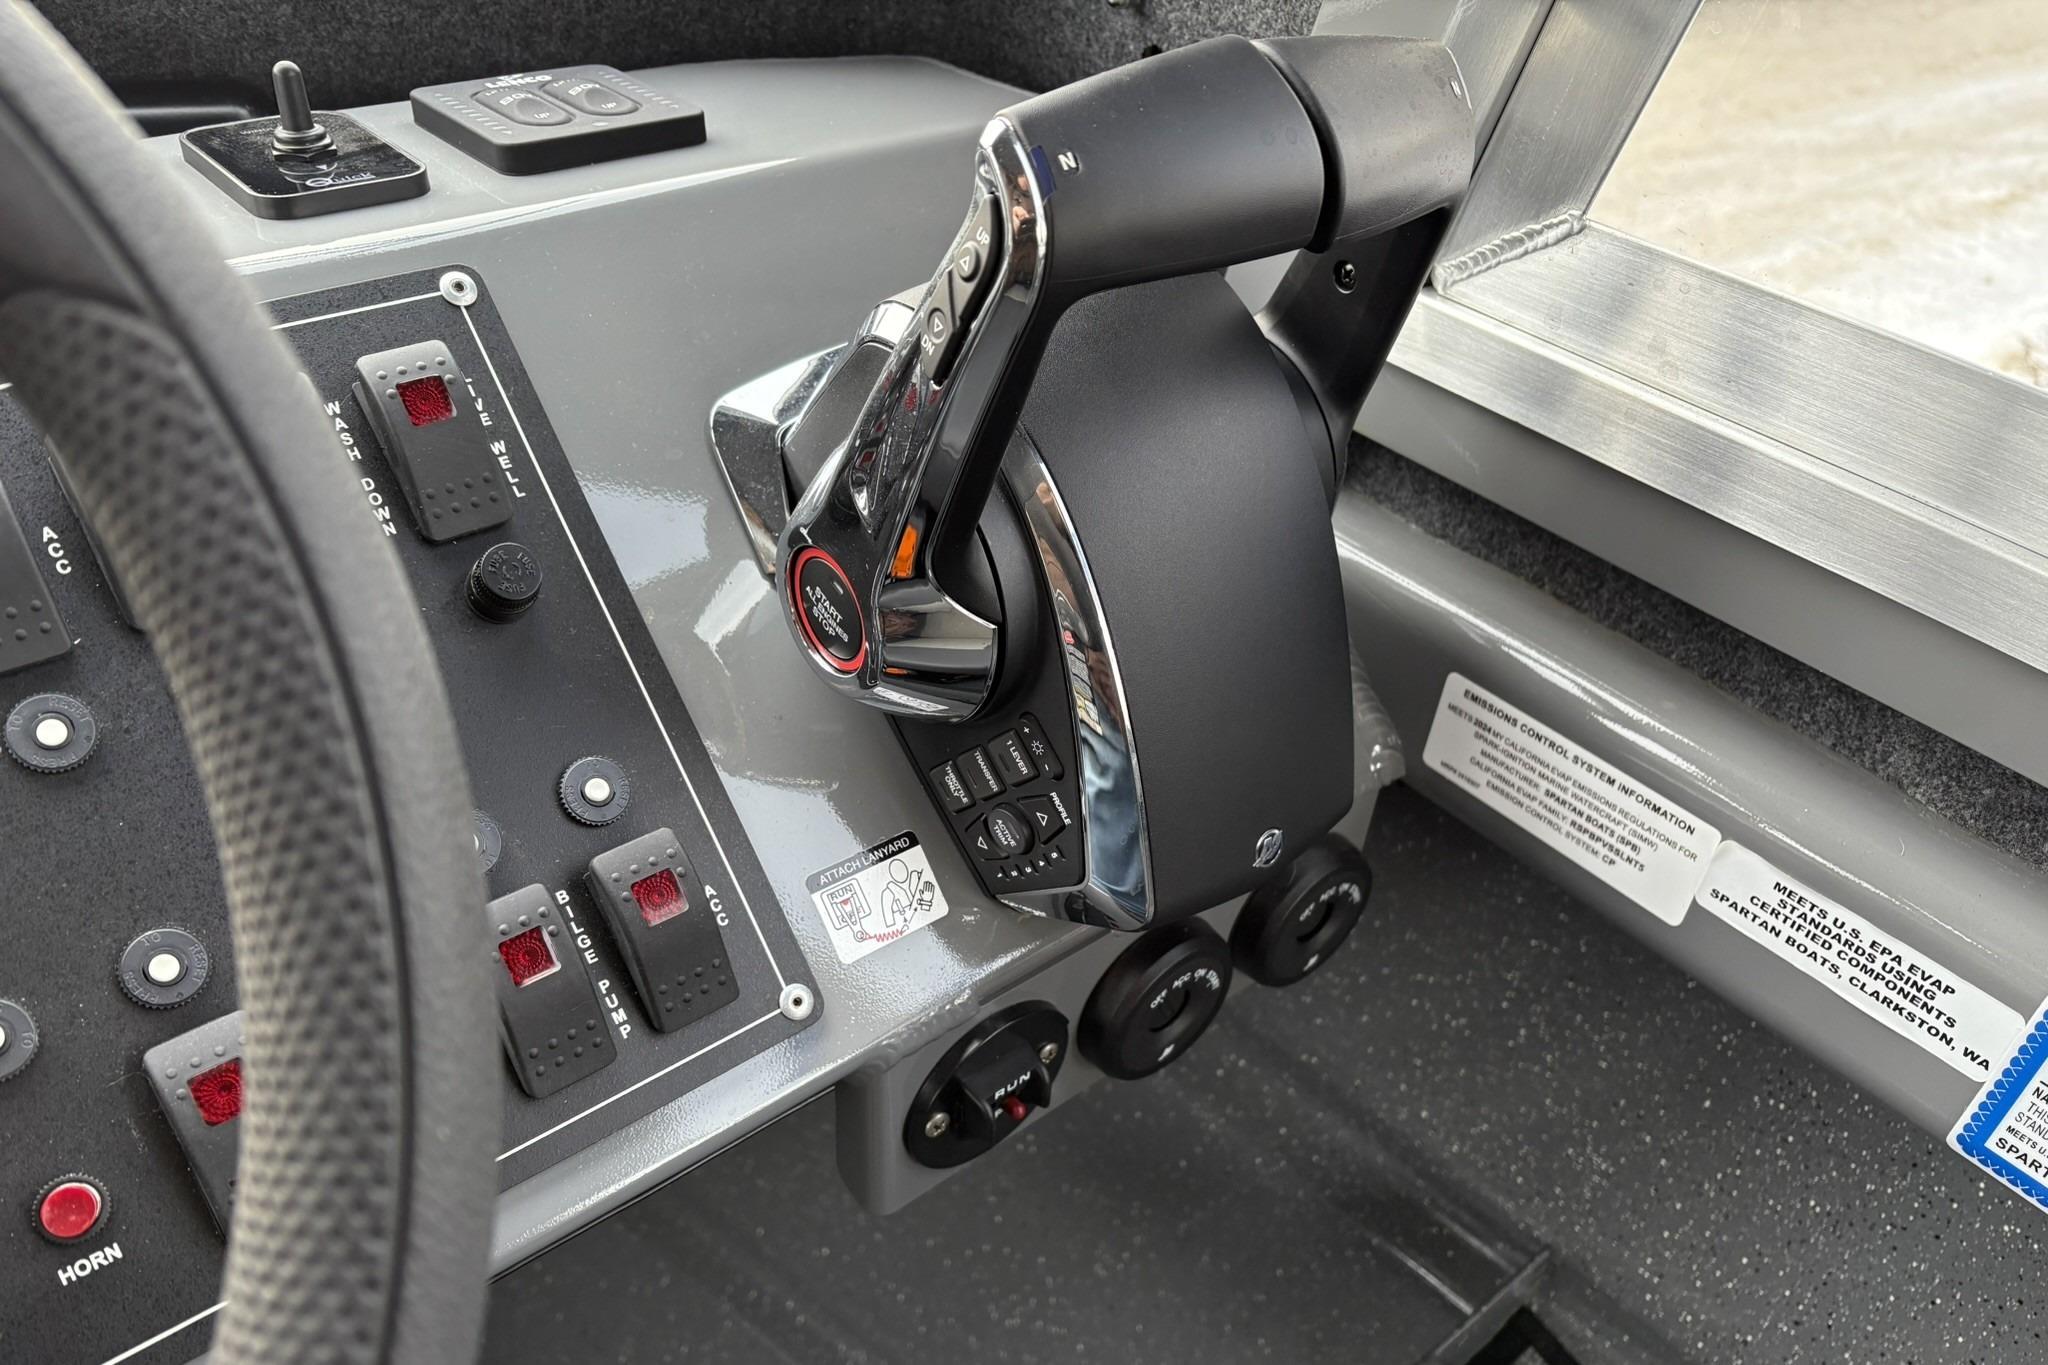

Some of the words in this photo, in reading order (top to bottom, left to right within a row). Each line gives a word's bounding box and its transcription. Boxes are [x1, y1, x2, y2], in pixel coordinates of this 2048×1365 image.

[1058, 151, 1078, 171] N
[976, 226, 990, 246] UP
[920, 334, 936, 356] DN
[323, 400, 362, 462] WASH
[360, 477, 397, 537] DOWN
[490, 439, 527, 499] WELL
[42, 526, 72, 575] ACC
[517, 552, 536, 576] FUSE
[805, 585, 817, 607] ALL
[817, 602, 849, 643] ENGINES
[812, 606, 836, 637] STOP
[814, 586, 843, 623] START
[974, 750, 999, 792] TRANSFER
[1009, 746, 1028, 775] LEVER
[1448, 702, 1473, 722] MEETS
[1473, 717, 1492, 734] 2024
[1504, 737, 1550, 770] CALIFORNIA
[1551, 766, 1572, 782] EVAP
[1572, 780, 1618, 812] EMISSIONS
[1618, 806, 1678, 850] REGULATIONS
[1678, 844, 1698, 862] FOR
[1464, 689, 1518, 728] EMISSIONS
[1520, 723, 1569, 760] CONTROL
[1572, 754, 1617, 787] SYSTEM
[1617, 782, 1696, 836] INFORMATION
[1470, 756, 1515, 789] CALIFORNIA
[1516, 785, 1538, 802] EVAP
[1474, 731, 1537, 775] SPARK-IGNITION
[1538, 771, 1570, 795] MARINE
[1570, 791, 1628, 831] WATERCRAFT
[944, 776, 960, 799] ONLY
[945, 766, 968, 804] THROTTLE
[1049, 791, 1072, 826] PROFILE
[1544, 789, 1585, 818] SPARTAN
[1585, 814, 1615, 839] BOATS
[993, 825, 1009, 846] TRIM
[995, 818, 1017, 848] ACTIVE
[1525, 804, 1563, 835] CONTROL
[1601, 854, 1616, 866] CP
[819, 858, 861, 886] ATTACH
[861, 837, 910, 864] LANYARD
[704, 884, 729, 927] ACC
[831, 884, 852, 901] RUN
[1772, 881, 1829, 920] MEETS
[1832, 917, 1864, 943] U.S.
[1869, 940, 1903, 967] EPA
[1906, 963, 1957, 996] EVAP
[1777, 897, 1877, 965] STANDARDS
[1881, 962, 1937, 1002] USING
[555, 890, 599, 965] BILGE
[598, 979, 632, 1040] PUMP
[1709, 888, 1782, 938] SPARTAN
[1785, 935, 1843, 979] BOATS,
[1848, 975, 1957, 1052] CLARKSTON,
[1962, 1046, 1991, 1072] WA
[1750, 895, 1833, 951] CERTIFIED
[1836, 949, 1957, 1029] COMPONENTS
[1150, 988, 1168, 1009] OFF
[1172, 972, 1192, 989] ACC
[1193, 968, 1208, 982] ON
[994, 1071, 1031, 1100] RUN
[2006, 1125, 2038, 1149] MEETS
[57, 1242, 123, 1287] HORN
